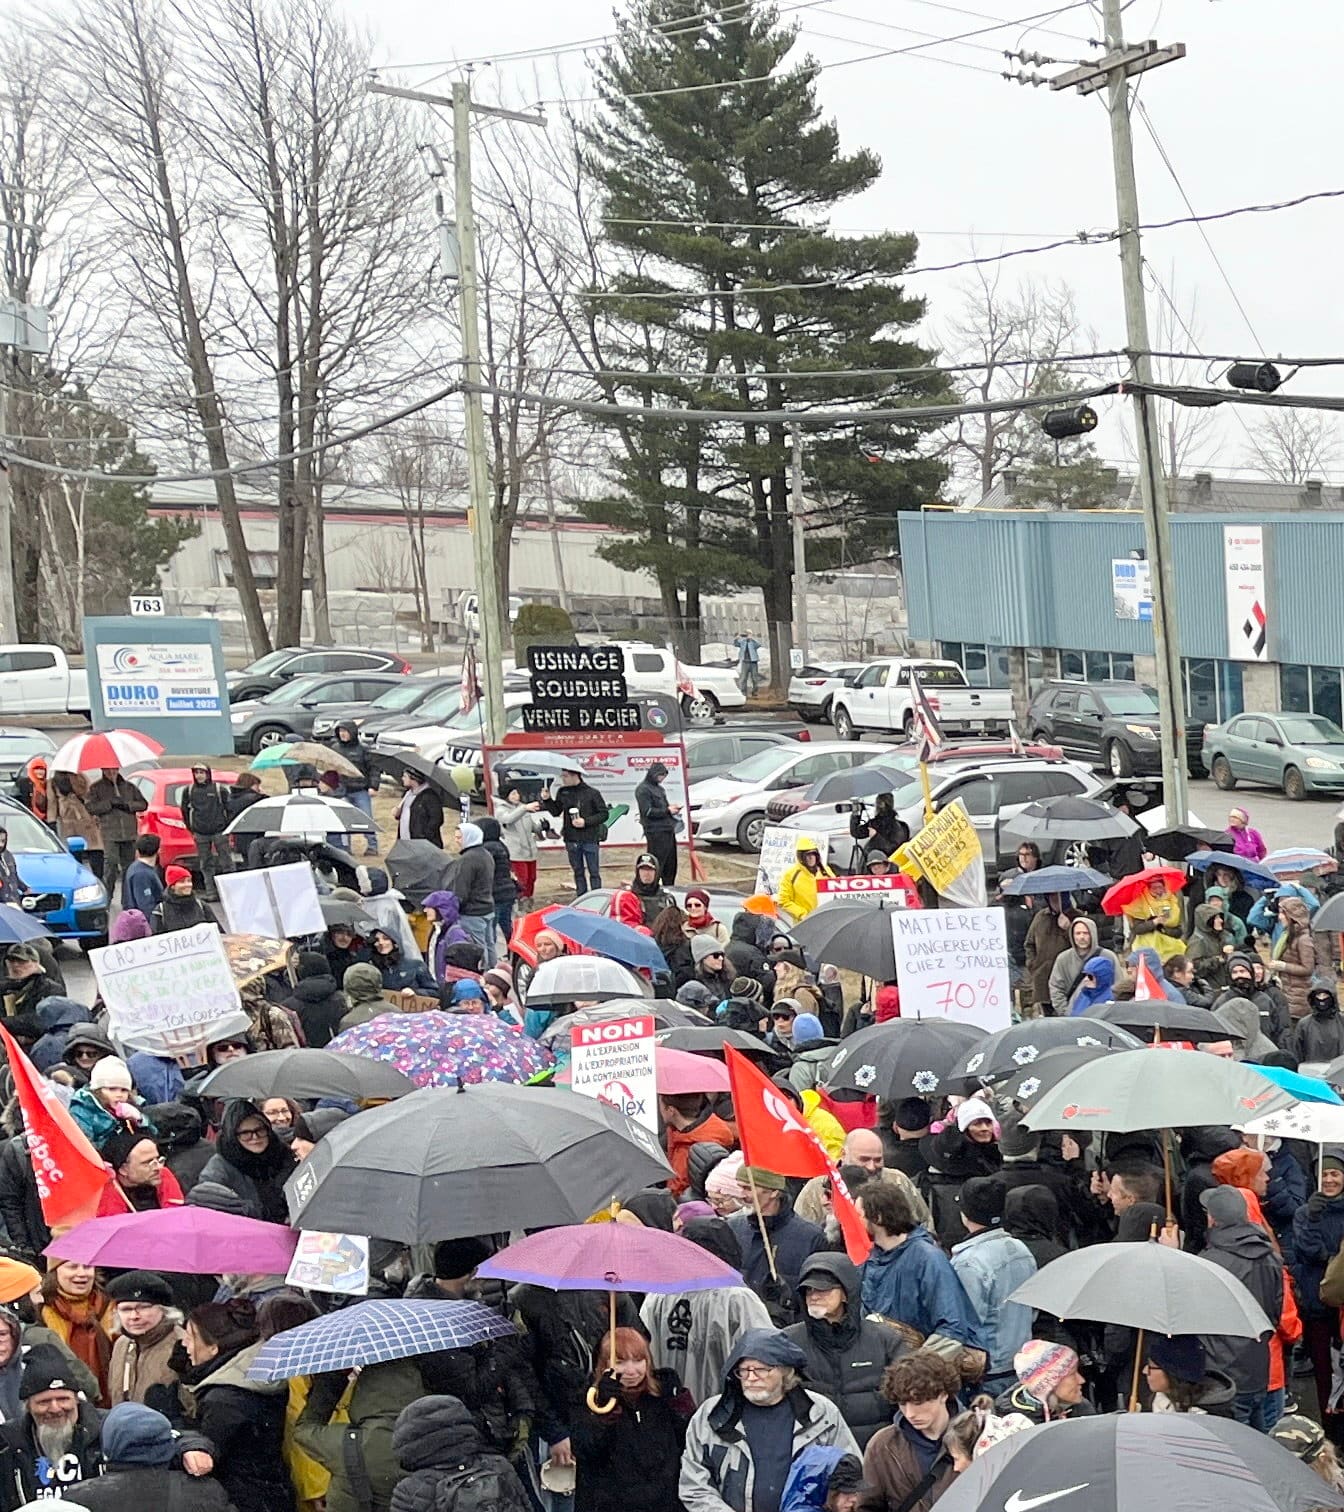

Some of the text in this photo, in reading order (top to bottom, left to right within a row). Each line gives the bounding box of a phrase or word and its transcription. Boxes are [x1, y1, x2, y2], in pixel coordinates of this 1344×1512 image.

[133, 600, 161, 612] 763
[533, 652, 619, 672] USINAGE
[107, 685, 159, 699] DURO
[535, 680, 621, 697] SOUDURE
[524, 708, 640, 727] VENTE D'ACIER
[827, 877, 893, 890] NON
[899, 912, 997, 934] MATIÈRES
[907, 937, 1005, 957] DANGEREUSES
[905, 957, 945, 974] CHEZ
[926, 975, 999, 1013] 70%
[582, 1021, 643, 1043] NON
